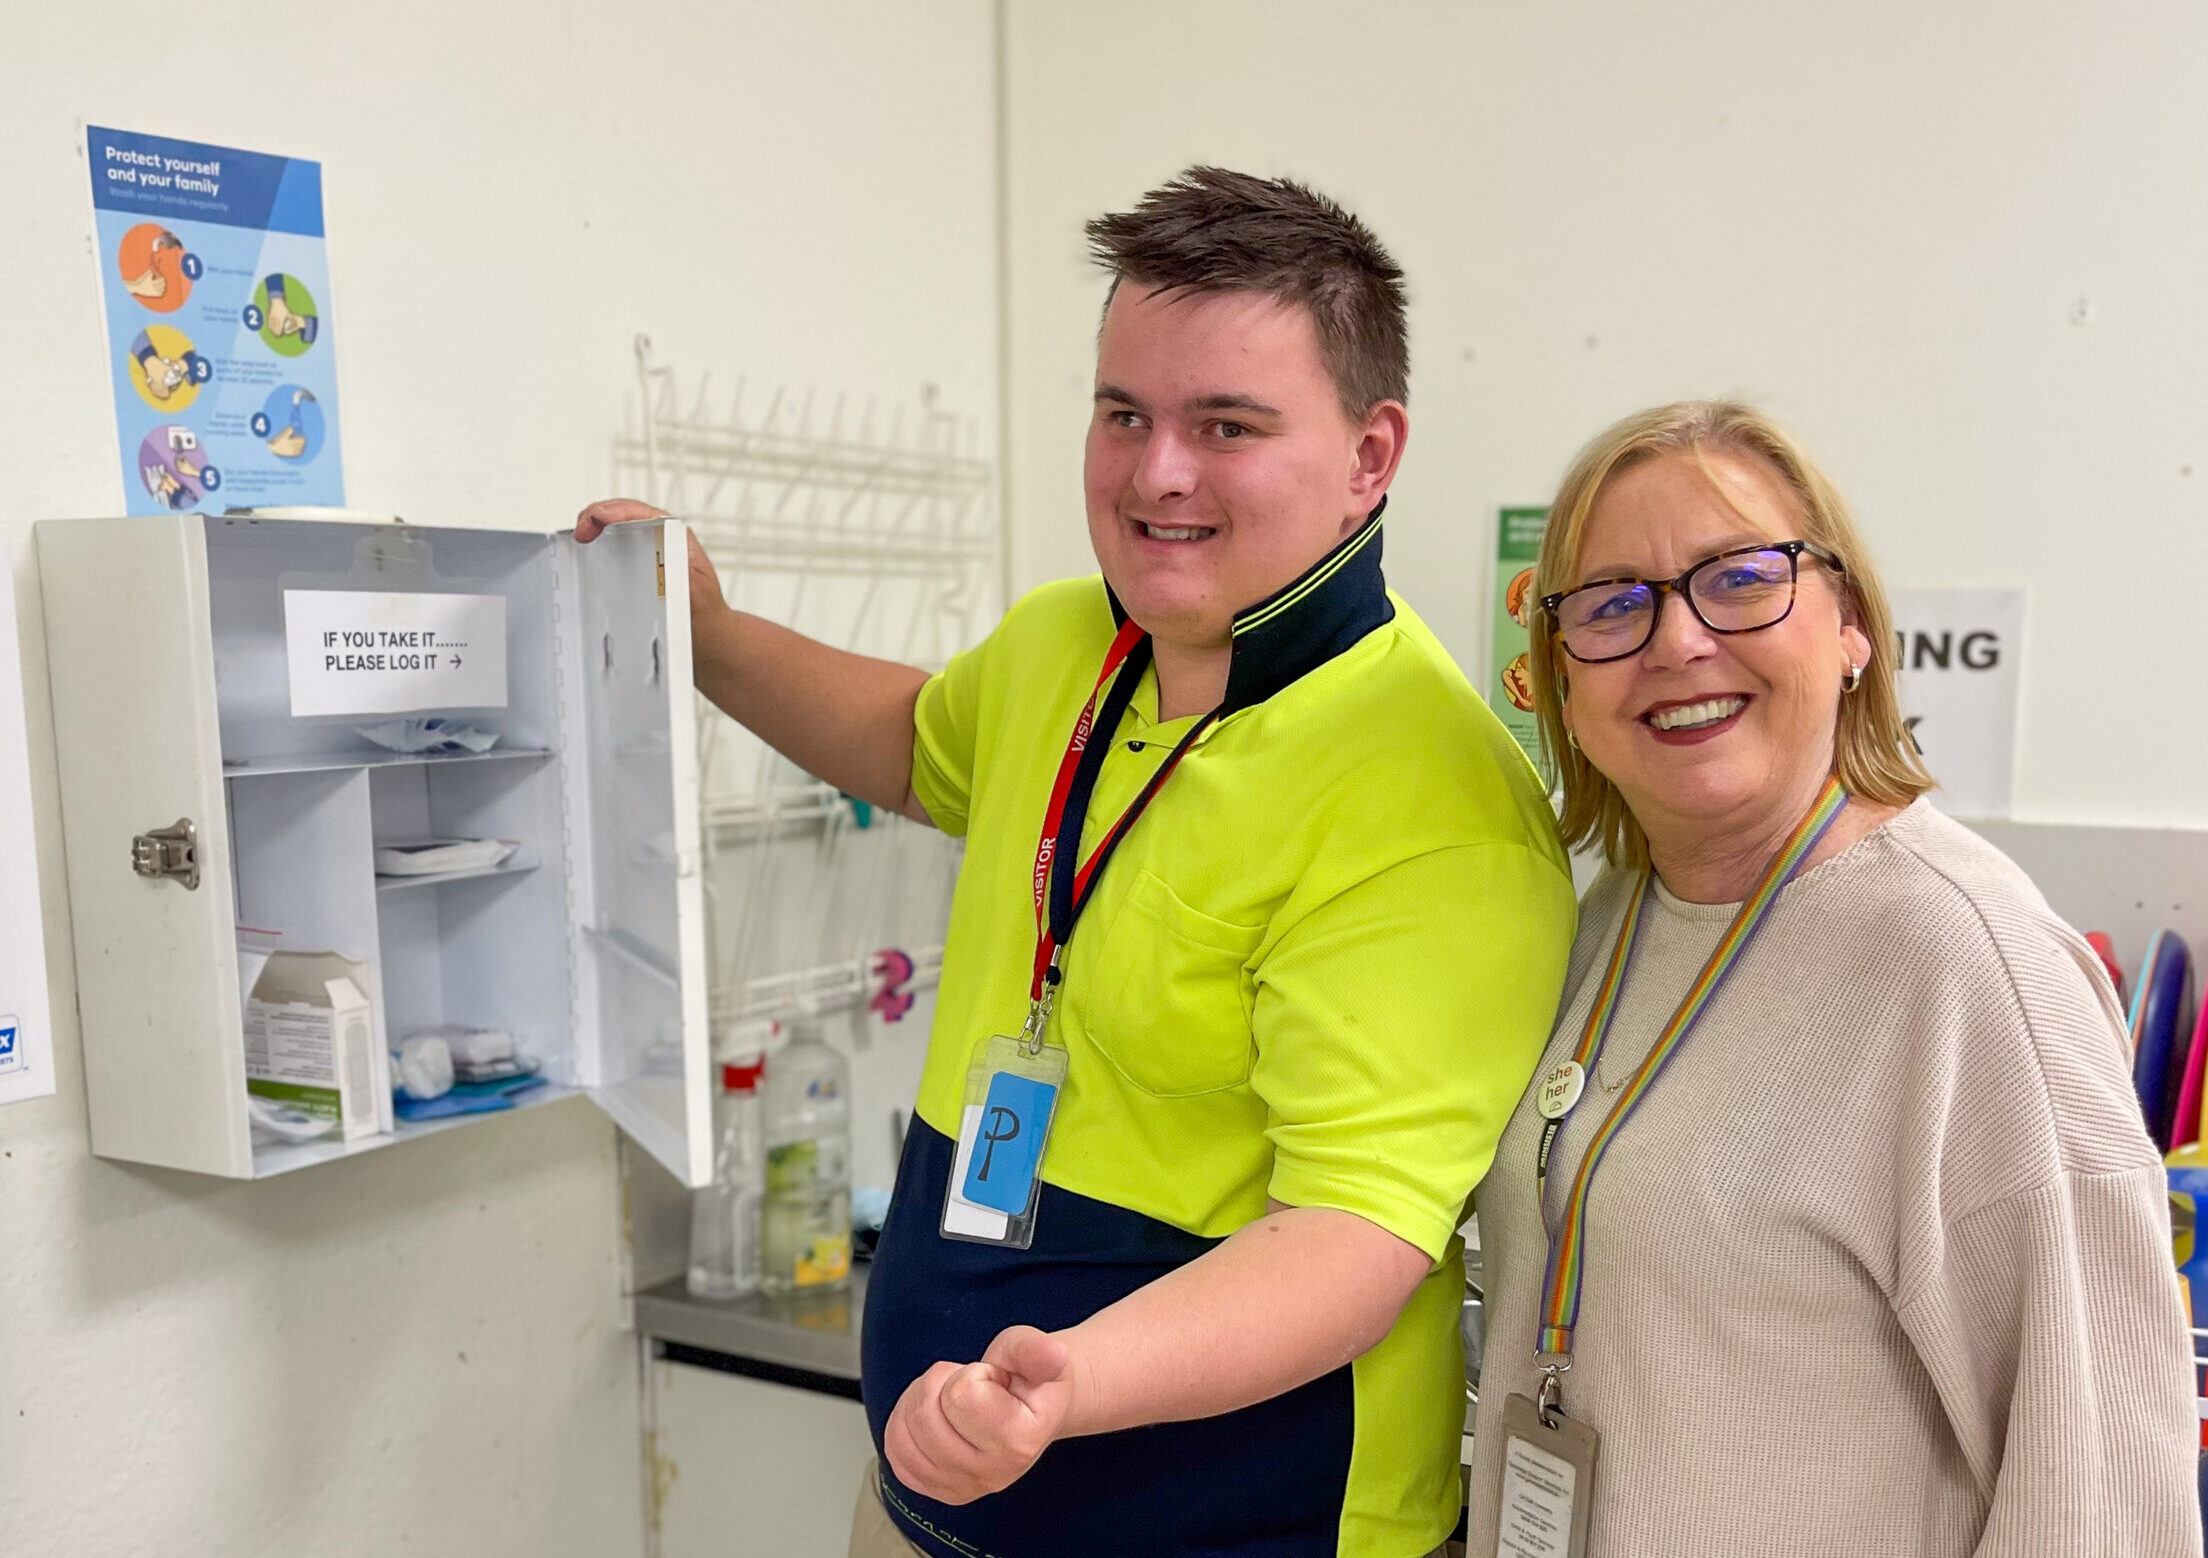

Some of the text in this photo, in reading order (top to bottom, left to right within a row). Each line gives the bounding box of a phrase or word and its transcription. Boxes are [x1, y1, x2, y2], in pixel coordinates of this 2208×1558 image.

[105, 146, 220, 177] Protect yourself
[107, 168, 219, 197] and your family
[187, 258, 196, 275] 1
[247, 309, 258, 326] 2
[196, 361, 207, 378] 3
[255, 417, 266, 433] 4
[205, 470, 216, 486] 5
[323, 632, 337, 647] IF
[342, 632, 375, 648] YOU
[378, 632, 418, 648] TAKE
[325, 654, 438, 671] PLEASE LOG IT
[1034, 837, 1056, 907] VISITOR
[1547, 1066, 1572, 1084] she
[1545, 1082, 1570, 1100] her
